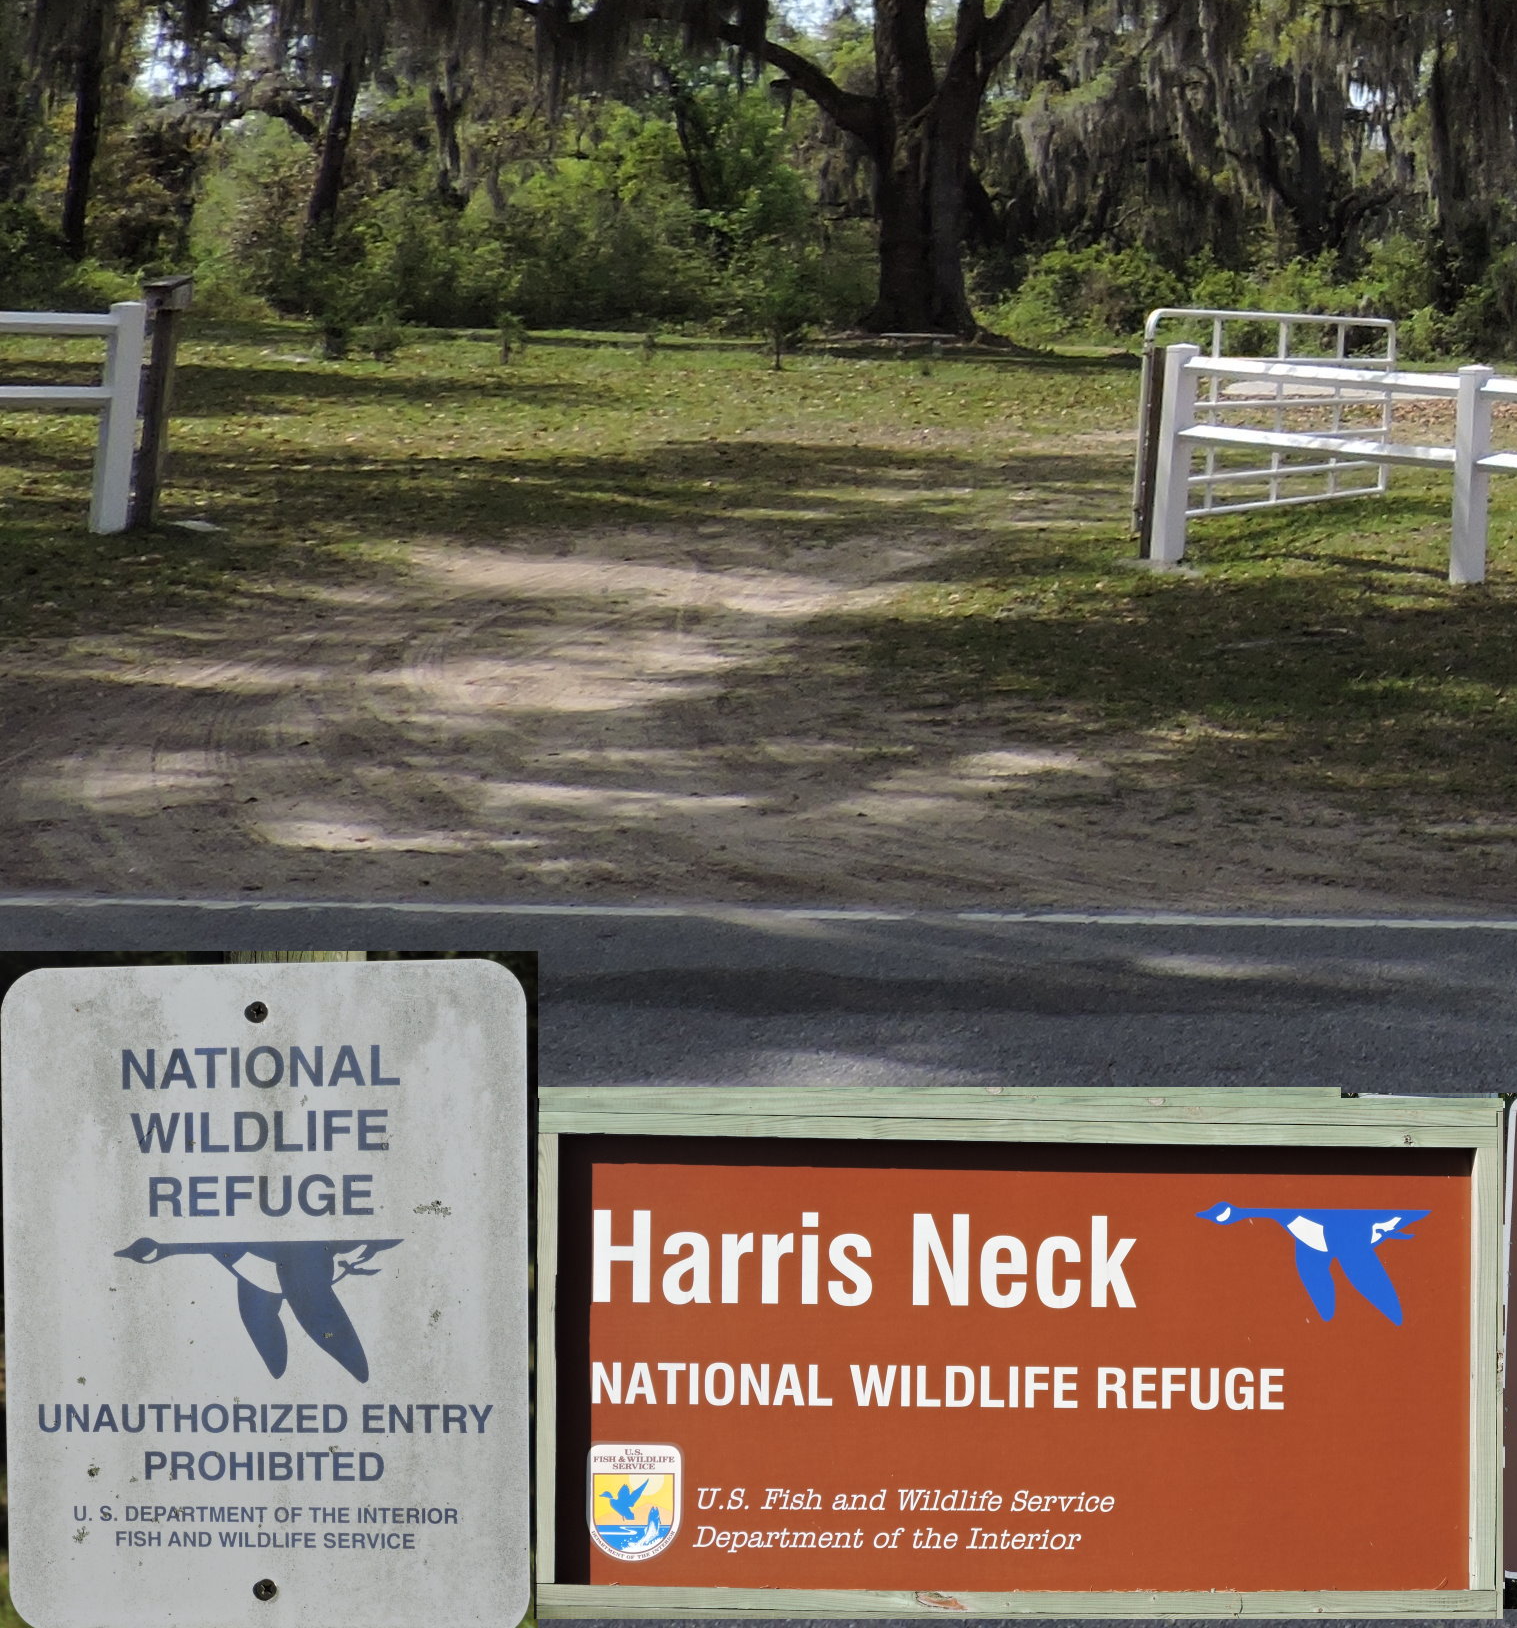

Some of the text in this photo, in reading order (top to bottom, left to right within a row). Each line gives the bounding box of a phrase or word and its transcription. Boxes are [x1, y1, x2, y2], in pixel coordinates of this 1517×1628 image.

[122, 1045, 400, 1090] NATIONAL
[131, 1109, 389, 1153] WILDLIFE
[149, 1174, 374, 1217] REFUGE
[592, 1209, 1137, 1309] Harris Neck
[591, 1361, 1285, 1411] NATIONAL WILDLIFE REFUGE
[37, 1404, 493, 1434] UNAUTHORIZED ENTRY
[144, 1451, 384, 1482] PROHIBITED
[593, 1455, 675, 1463] FISH & WILDLIFE
[624, 1448, 643, 1456] U.S.
[125, 1505, 268, 1523] DEPARTMENT
[274, 1506, 302, 1523] OF
[309, 1507, 350, 1523] THE
[357, 1507, 458, 1524] INTERIOR
[697, 1487, 1116, 1513] U.S. Fish and Wildlife Service
[115, 1530, 416, 1550] FISH AND WILDLIFE SERVICE
[691, 1525, 1082, 1554] Department of the Interior
